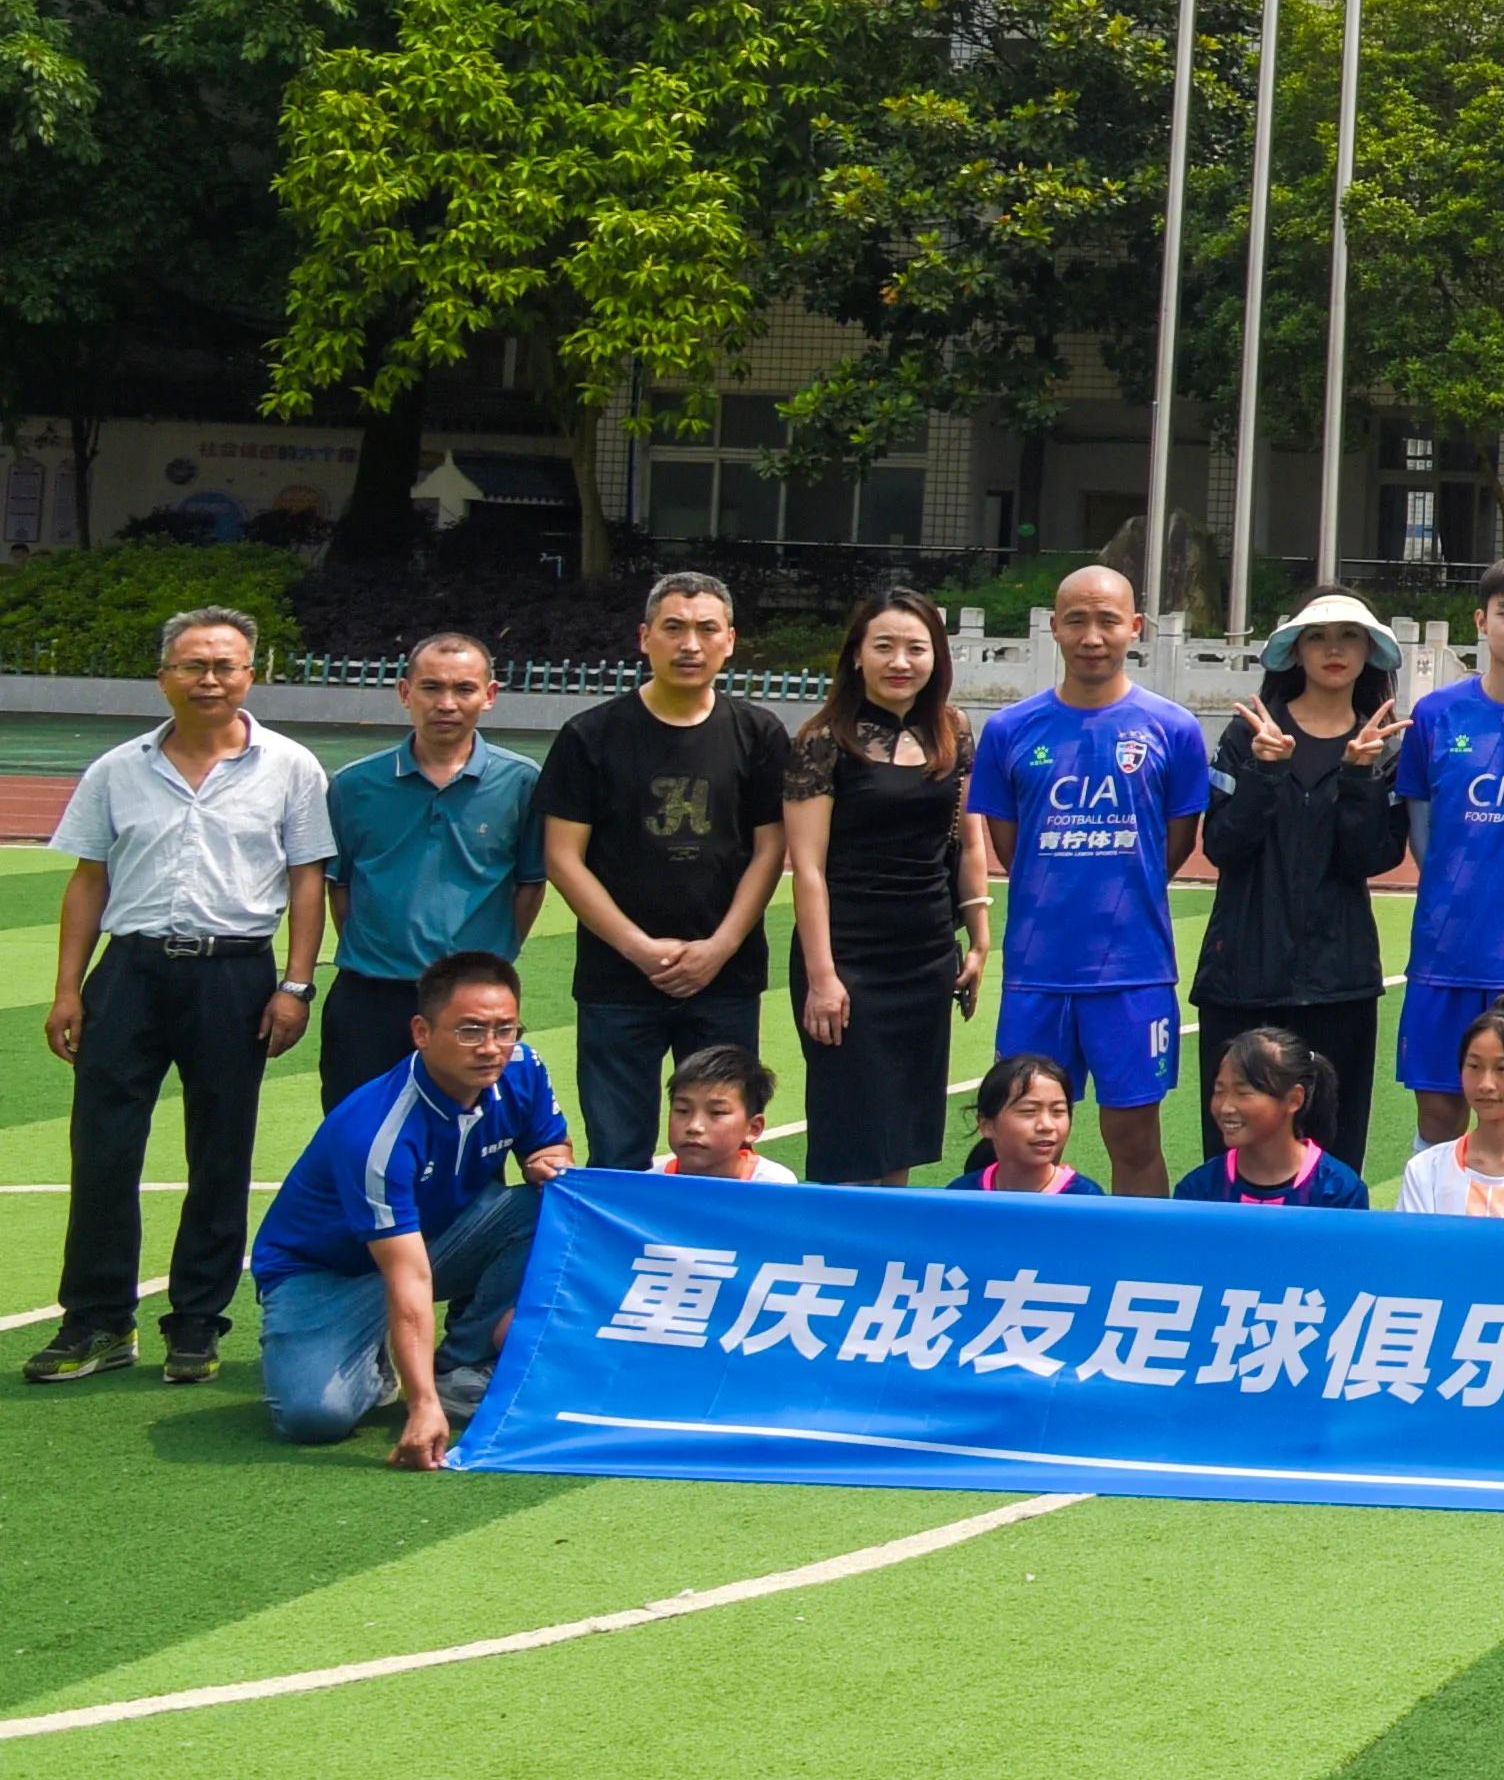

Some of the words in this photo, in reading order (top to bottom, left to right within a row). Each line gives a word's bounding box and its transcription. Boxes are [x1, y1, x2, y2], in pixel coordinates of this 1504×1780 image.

[1049, 774, 1120, 810] CIA
[1047, 814, 1106, 826] FOOTBALL
[1107, 814, 1137, 825] CLUB
[1039, 830, 1138, 850] 青柠体育
[1151, 1018, 1170, 1058] 16
